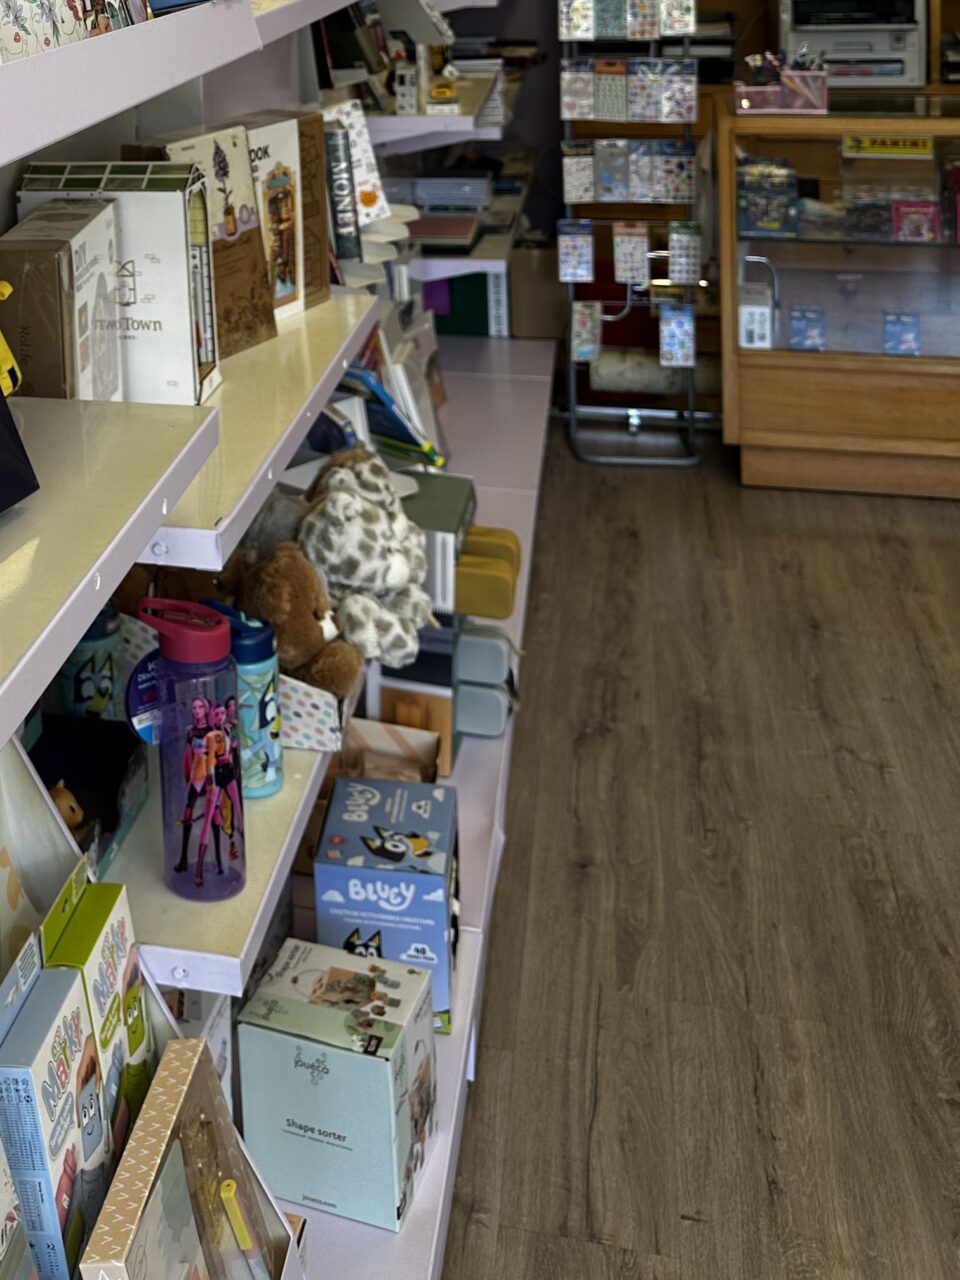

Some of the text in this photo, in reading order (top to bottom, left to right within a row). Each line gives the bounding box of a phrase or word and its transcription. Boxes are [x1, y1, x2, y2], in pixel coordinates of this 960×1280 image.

[250, 144, 271, 163] OOK
[331, 161, 355, 237] MONET
[285, 1118, 316, 1136] Shape
[316, 1127, 347, 1143] sorter
